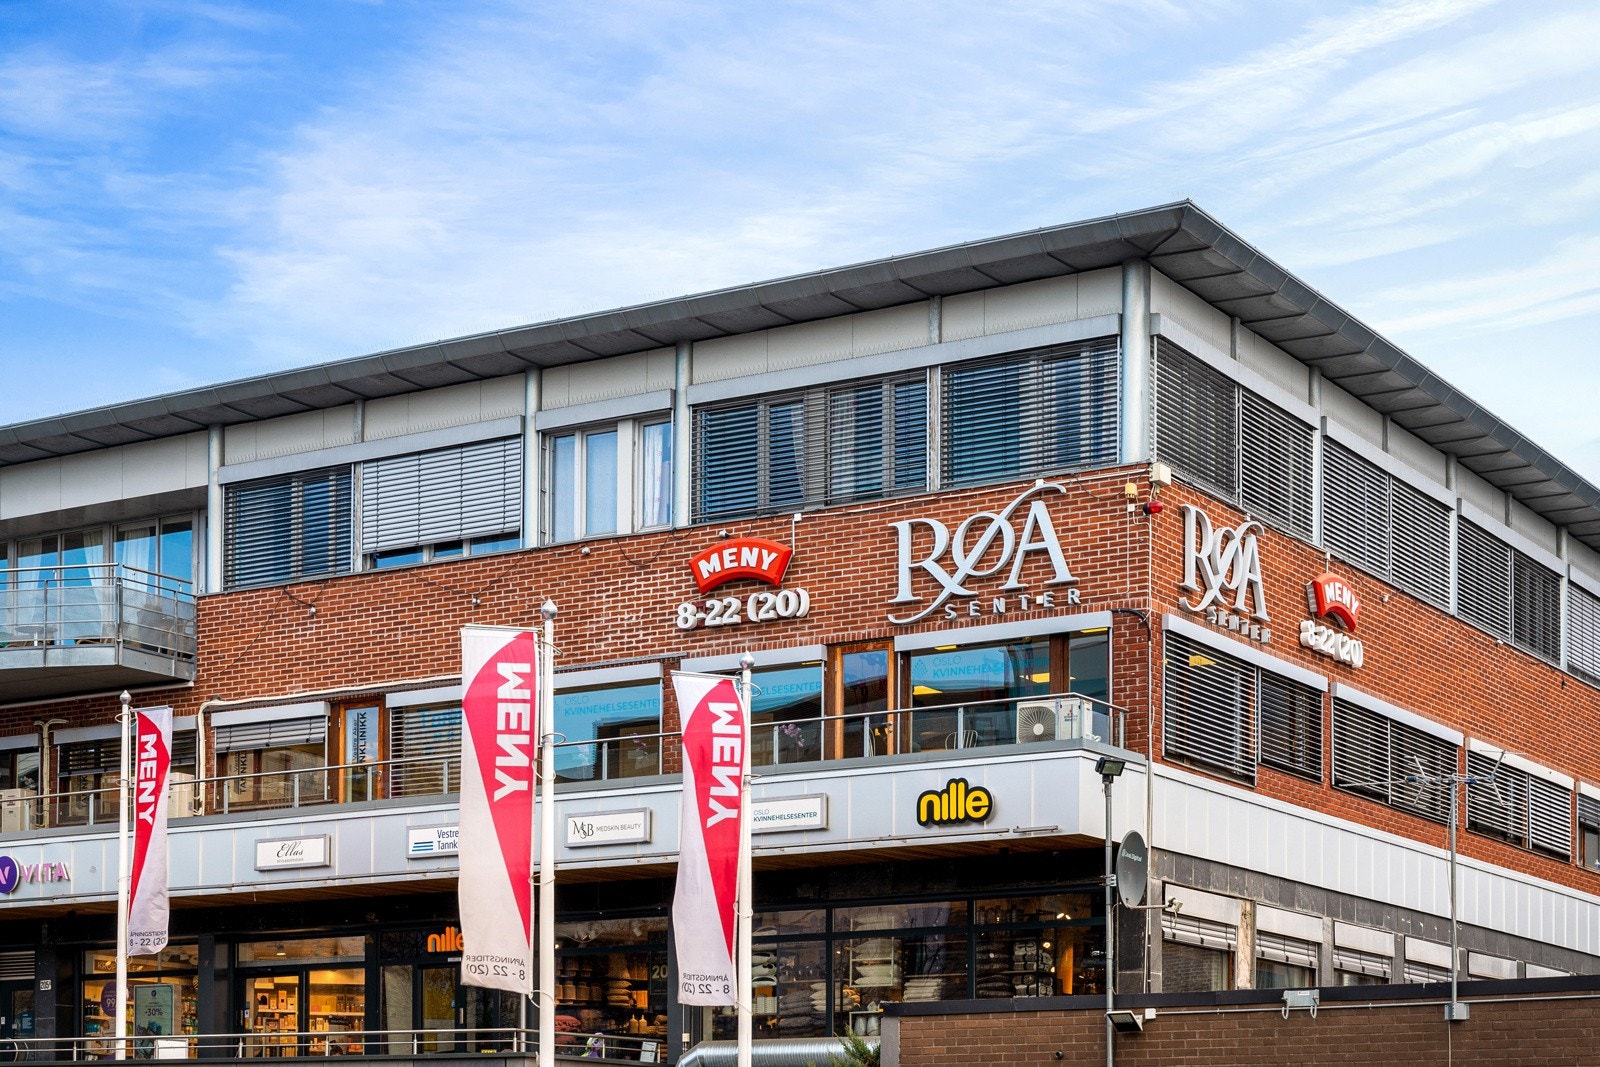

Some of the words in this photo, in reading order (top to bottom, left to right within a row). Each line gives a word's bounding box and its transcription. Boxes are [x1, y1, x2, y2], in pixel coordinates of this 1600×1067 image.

[698, 547, 778, 579] MENY
[888, 484, 1080, 624] RØA
[677, 597, 741, 629] 8-22
[747, 588, 810, 622] (20)
[945, 588, 1081, 619] SENTER
[1324, 582, 1360, 615] MENY
[564, 696, 589, 705] OSLO
[564, 698, 660, 716] KVINNEHELSESENTE
[138, 734, 157, 825] MENY
[919, 780, 990, 823] nille
[753, 808, 769, 816] OSLO
[753, 811, 818, 823] KVINNEHELSESENTER
[436, 829, 459, 839] Vestre
[620, 823, 641, 831] BEAUTY
[276, 841, 304, 858] Ellas
[20, 861, 69, 883] VITA
[130, 938, 134, 946] 8
[140, 938, 151, 946] 22
